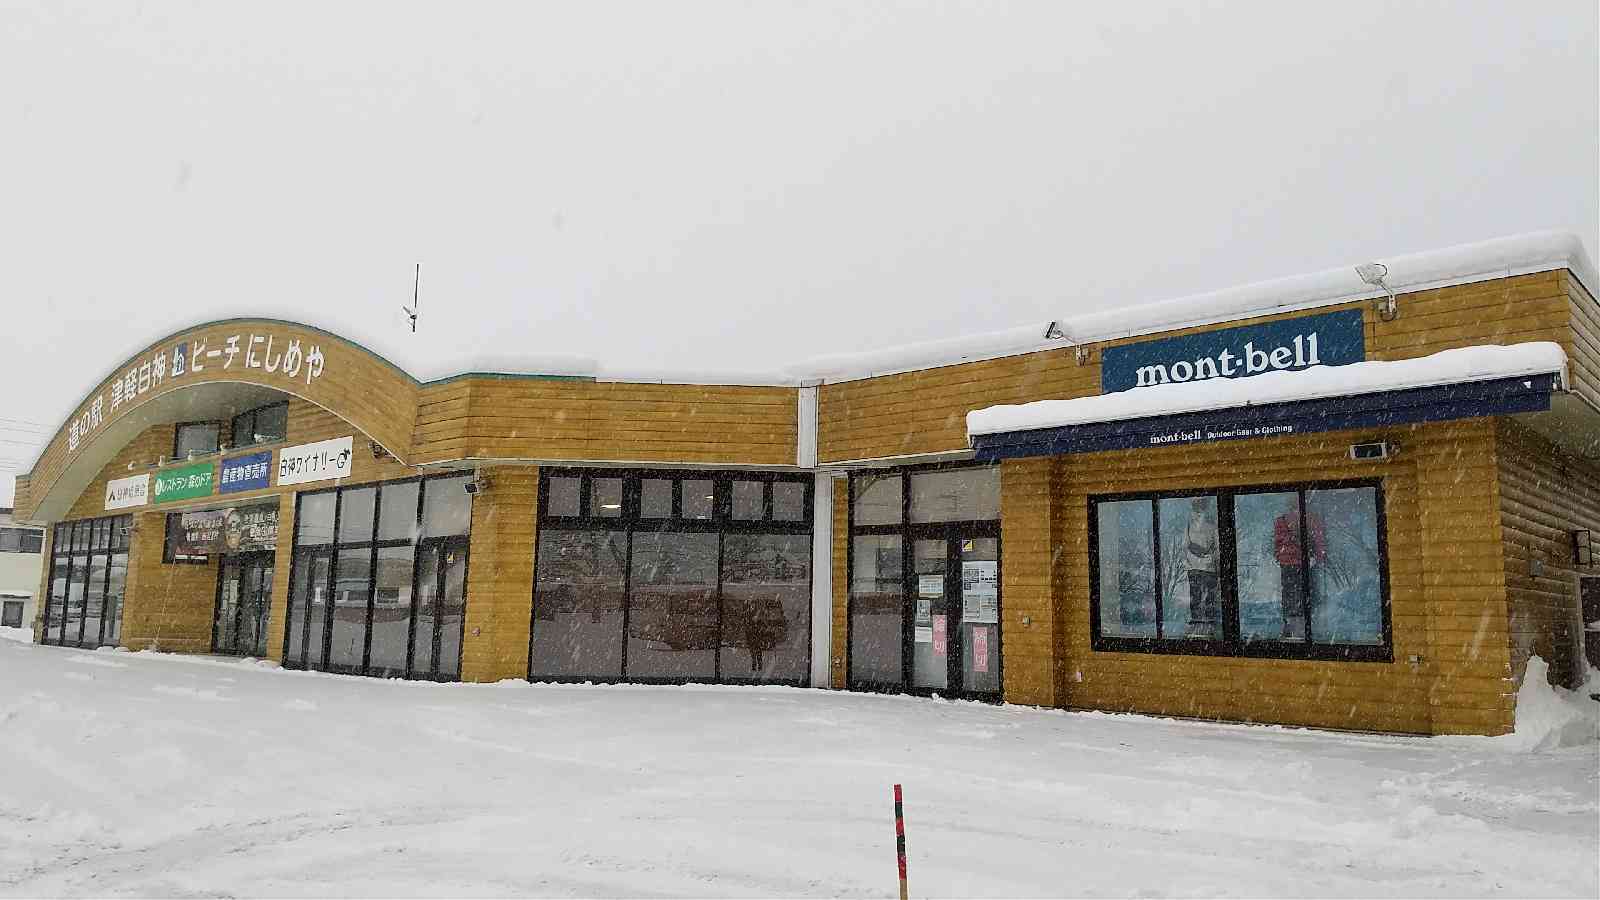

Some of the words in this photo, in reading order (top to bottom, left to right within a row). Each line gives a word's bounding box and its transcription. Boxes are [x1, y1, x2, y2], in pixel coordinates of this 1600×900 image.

[68, 394, 104, 453] 道の駅
[110, 351, 167, 414] 津軽白神
[1207, 430, 1235, 440] Outdoor
[1261, 424, 1293, 435] Clothing
[280, 450, 336, 478] 白神ワイナリー
